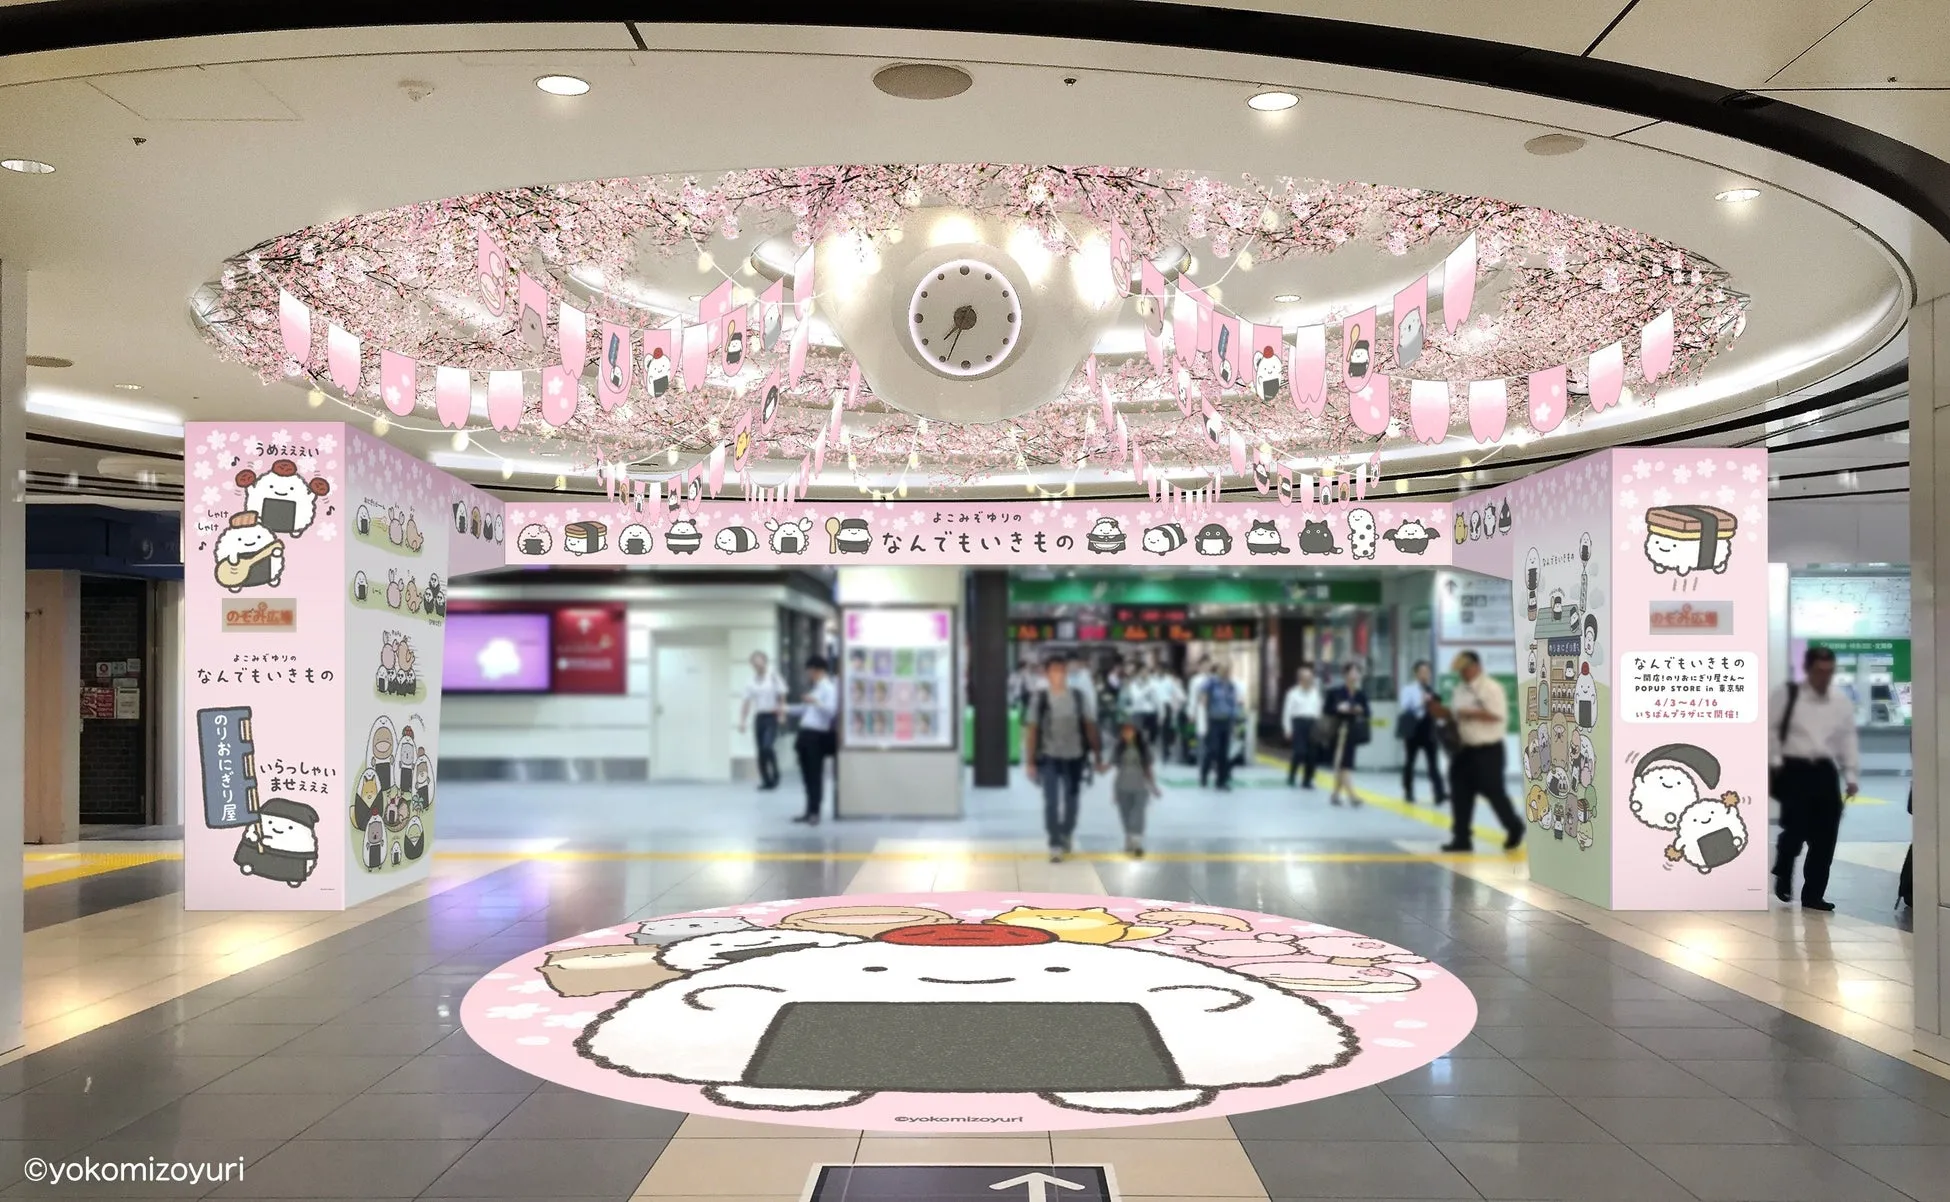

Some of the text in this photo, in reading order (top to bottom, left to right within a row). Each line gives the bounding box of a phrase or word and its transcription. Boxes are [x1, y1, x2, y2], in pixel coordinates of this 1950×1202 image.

[207, 509, 229, 519] しゃけ
[932, 510, 1023, 524] よこみぞゆりの
[197, 522, 219, 532] しゃけ
[882, 530, 1074, 554] なんでもいきもの
[233, 653, 297, 663] よこみぞゆりの
[1634, 656, 1745, 670] なんでもいきもの
[197, 667, 334, 684] なんでもいきもの
[214, 713, 238, 822] のりおにぎり屋
[260, 758, 336, 777] いらっしゃい
[894, 1115, 1024, 1124] ©yokomizoyuri
